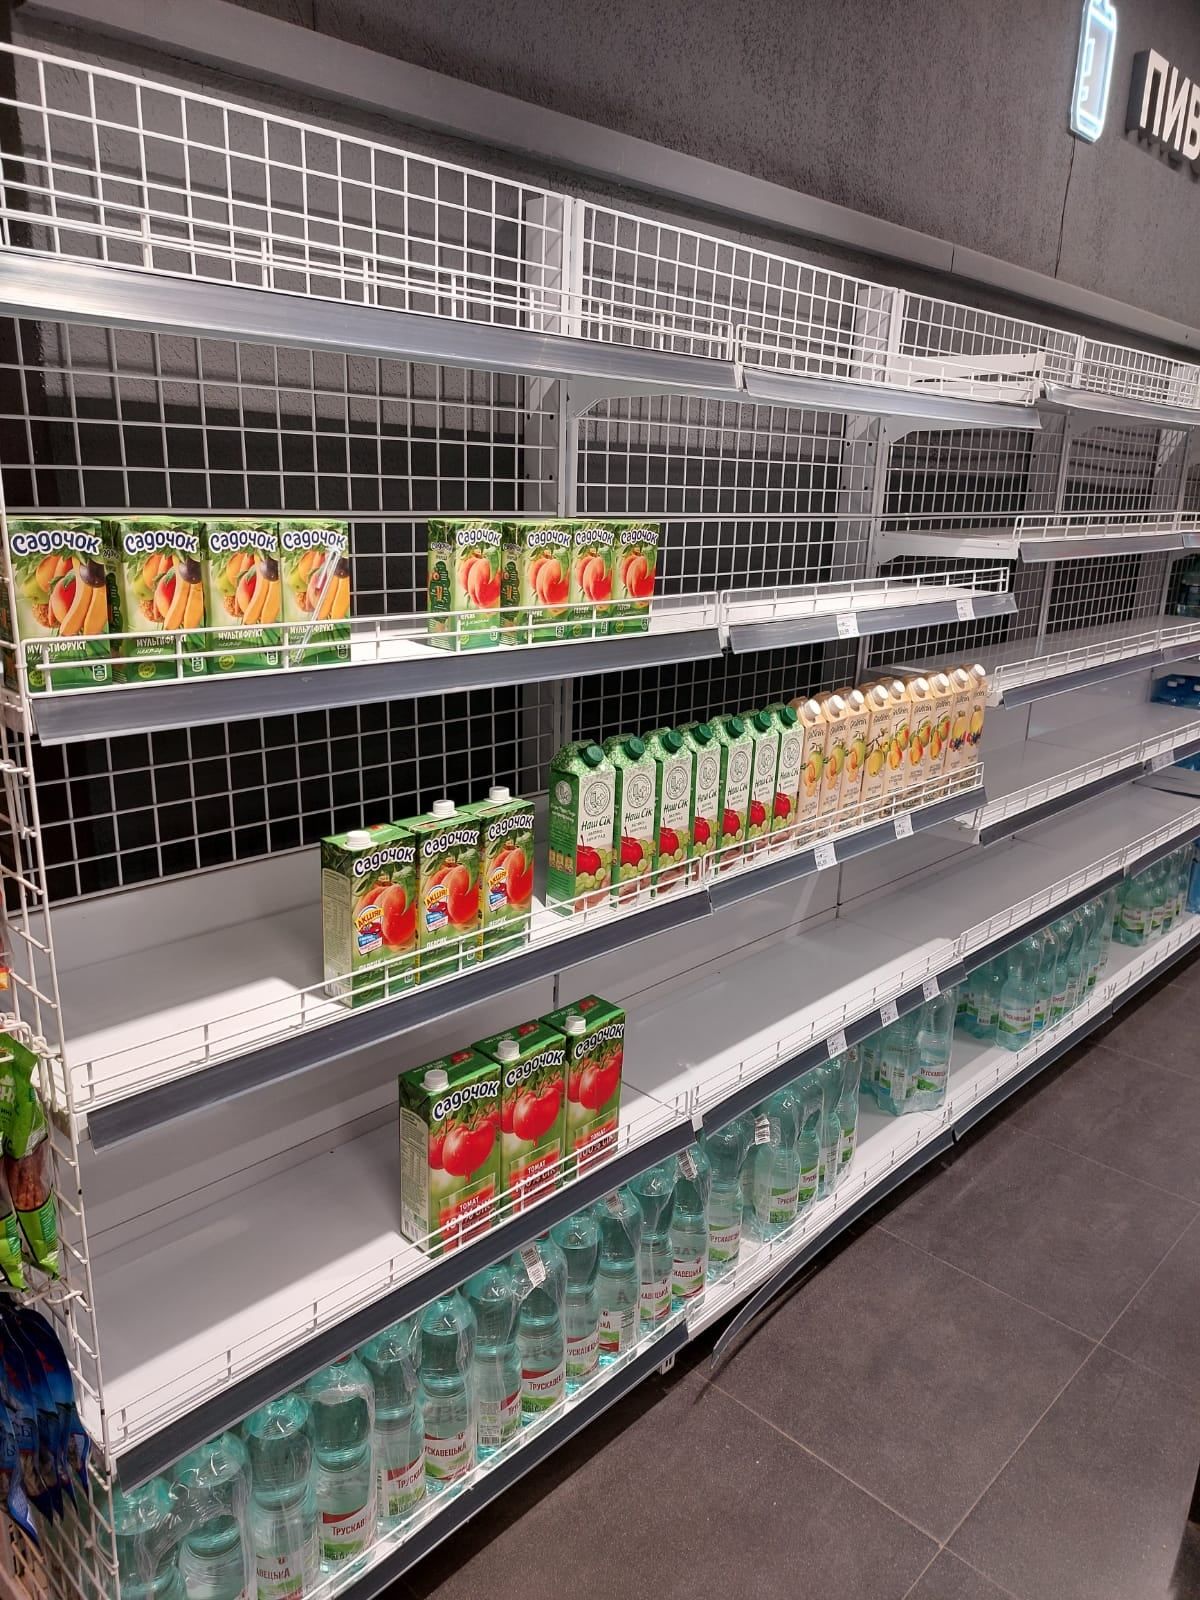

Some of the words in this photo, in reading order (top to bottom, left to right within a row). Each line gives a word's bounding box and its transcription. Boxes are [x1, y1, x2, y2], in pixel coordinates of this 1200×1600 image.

[12, 530, 101, 555] Садочок
[125, 530, 199, 552] Садочок
[209, 530, 278, 551] Садочок
[282, 530, 346, 550] Садочок
[457, 528, 502, 546] Садочок
[527, 529, 571, 547] Садочок
[575, 528, 615, 546] Садочок
[620, 528, 659, 546] Садочок
[218, 628, 265, 641] МУЛЬТИФРУКТ
[487, 815, 534, 839] Садочок
[424, 831, 478, 857] Садочок
[353, 848, 415, 876] Садочок
[575, 1024, 624, 1058] Садочок
[506, 1051, 565, 1086] Садочок
[433, 1082, 499, 1119] Садочок
[528, 1160, 545, 1174] ТОМАТ
[459, 1196, 479, 1212] ТОМАТ
